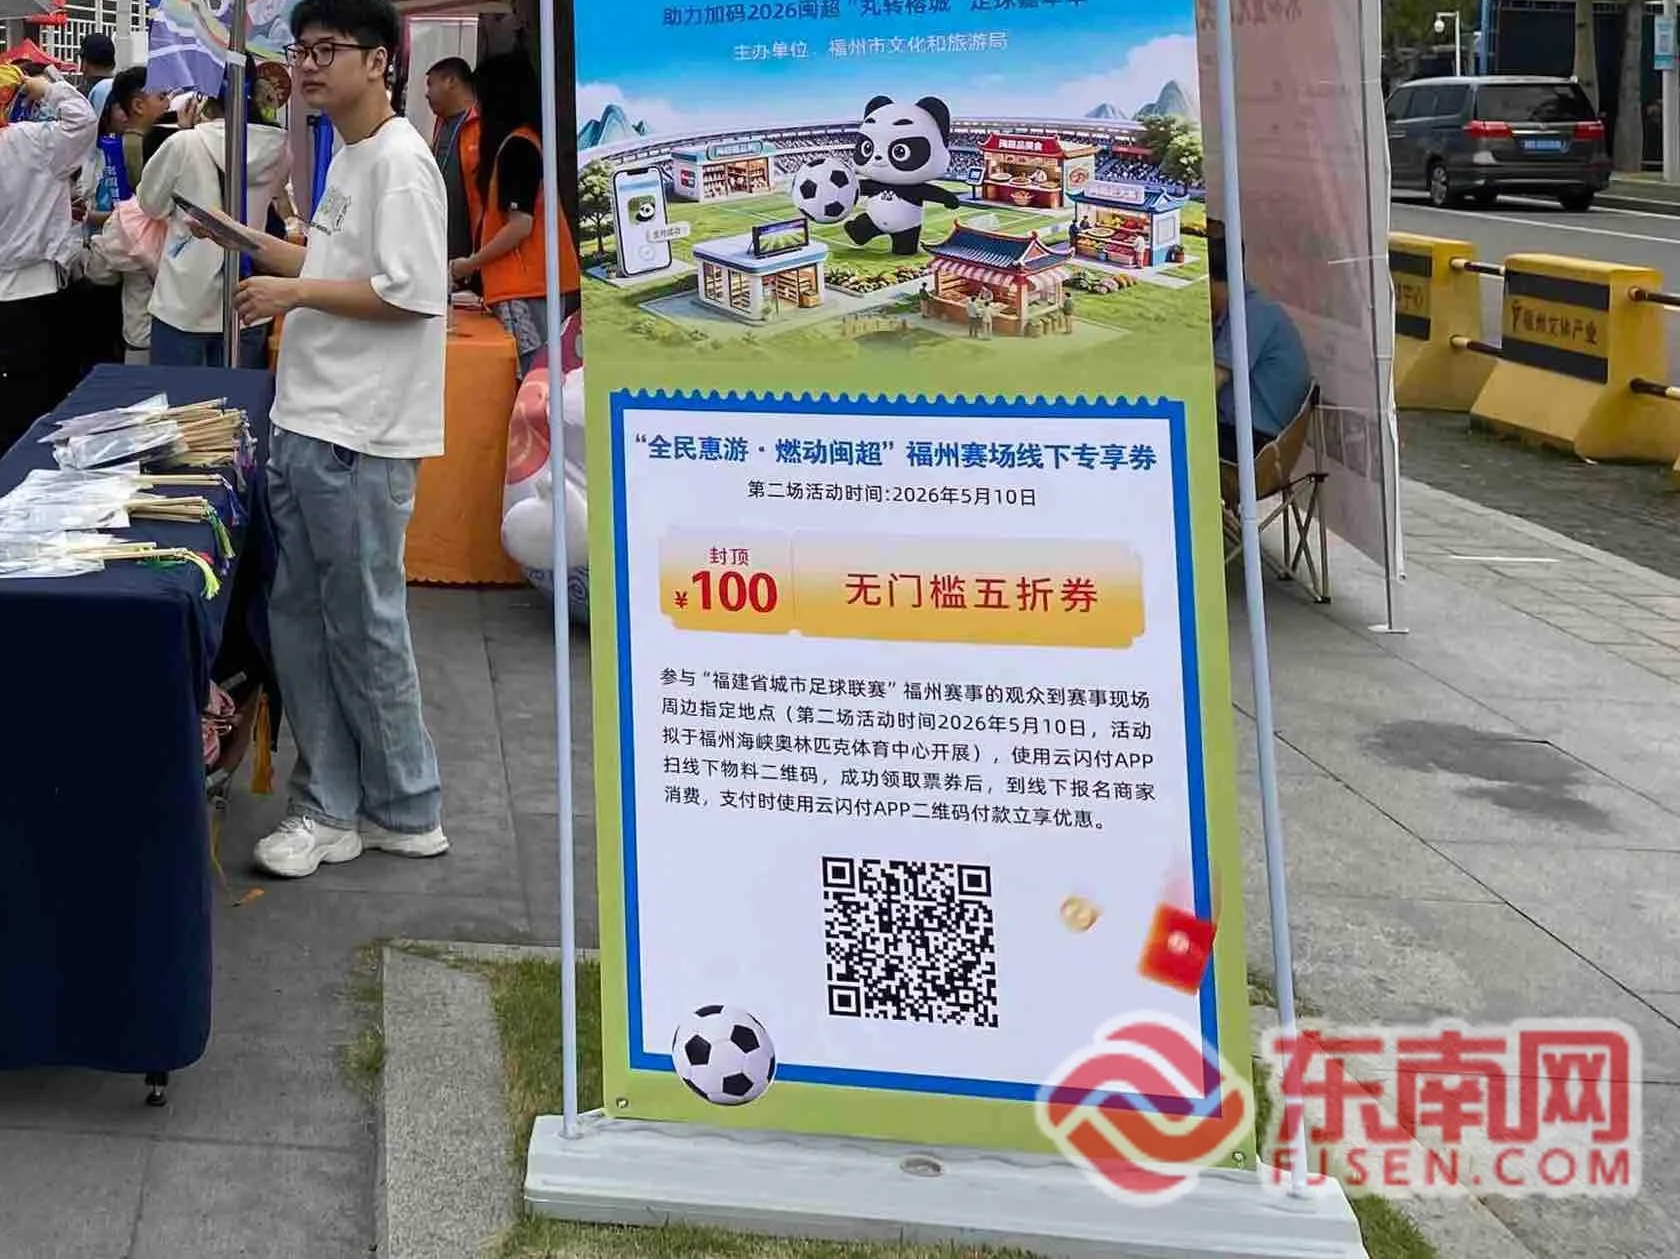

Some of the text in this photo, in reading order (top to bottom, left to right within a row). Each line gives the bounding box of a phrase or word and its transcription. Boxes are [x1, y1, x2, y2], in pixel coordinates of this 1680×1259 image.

[747, 480, 1037, 507] 第二场活动时间:2026年5月10日
[709, 546, 750, 566] 封顶
[845, 572, 1098, 613] 无门槛五折券
[659, 667, 1151, 710] 参与“福建省城市足球联赛”福州赛事的观众到赛事现场
[661, 697, 1152, 741] 周边指定地点（第二场活动时间2026年5月10日，活动
[662, 726, 1154, 769] 拟于福州海峡奥林匹克体育中心开展），使用云闪付APP
[663, 756, 1156, 801] 扫线下物料二维码，成功领取票券后，到线下报名商家
[664, 785, 1105, 831] 消费，支付时使用云闪付APP二维码付款立享优惠。
